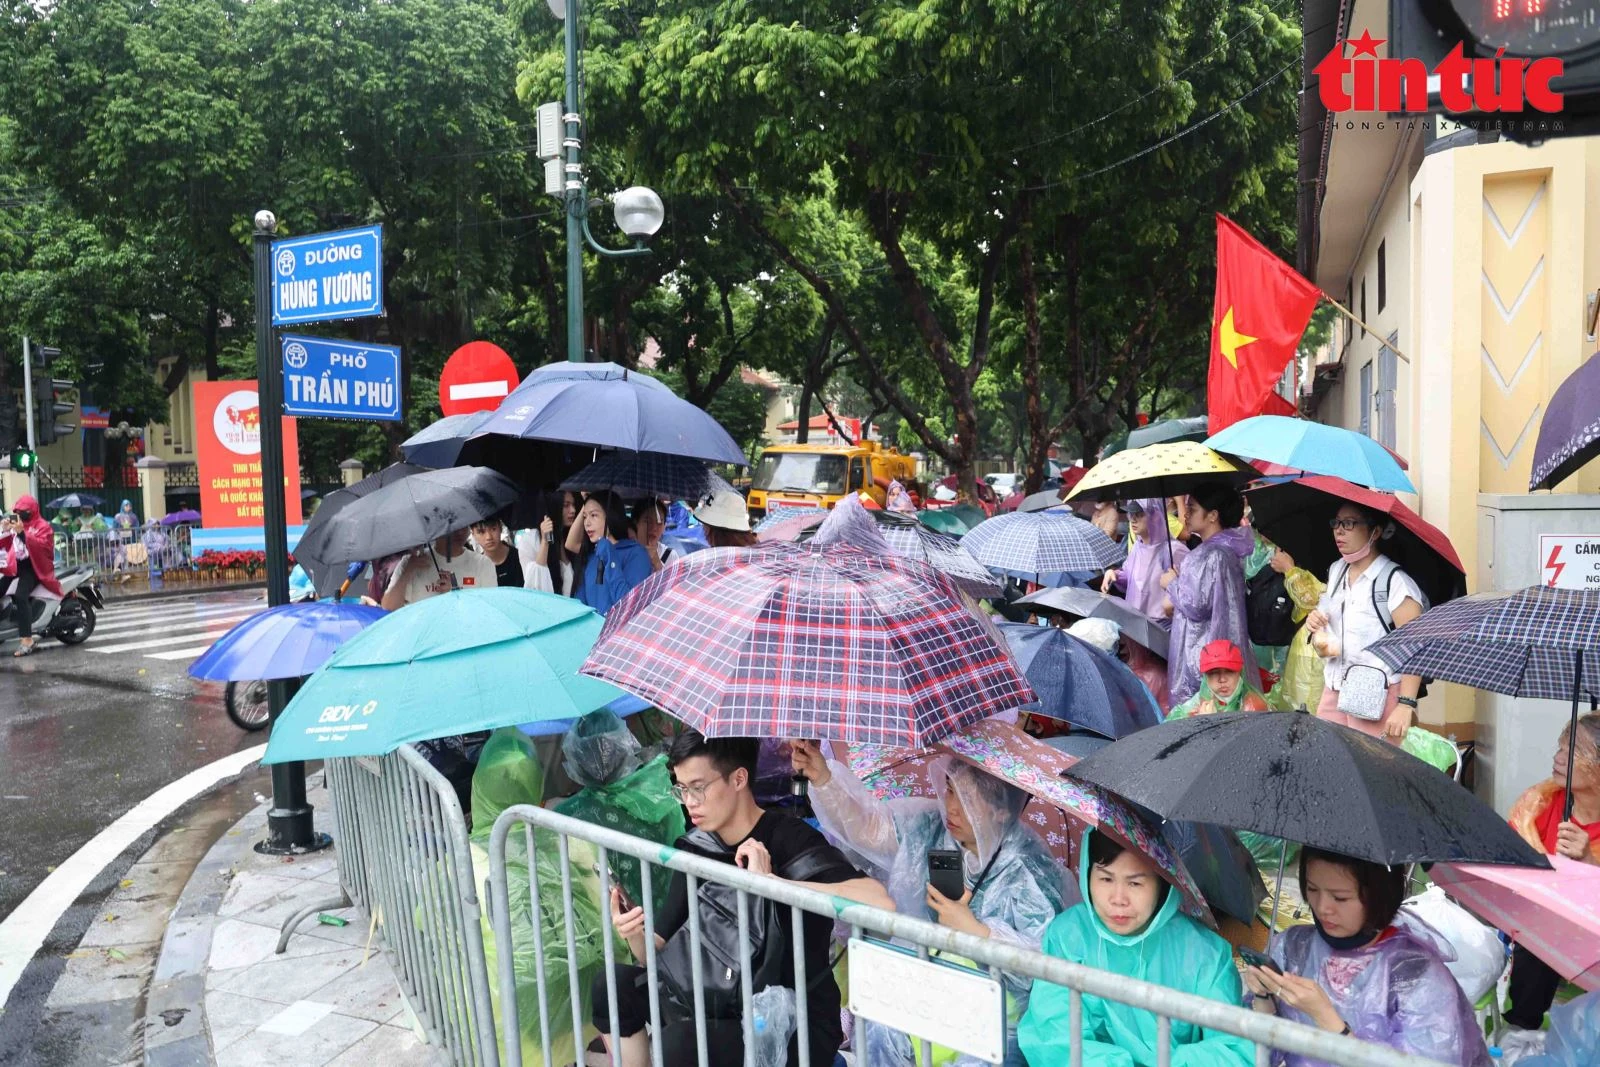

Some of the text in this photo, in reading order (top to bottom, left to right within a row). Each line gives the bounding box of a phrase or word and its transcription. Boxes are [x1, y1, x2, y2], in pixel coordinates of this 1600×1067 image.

[305, 243, 362, 266] ĐƯỜNG
[280, 271, 372, 310] HÙNG VƯƠNG
[330, 351, 368, 369] PHỐ
[288, 369, 393, 408] TRẦN PHÚ
[212, 475, 263, 490] CÁCH MẠNG THÁ
[220, 489, 263, 504] VÀ QUỐC KHÁ
[237, 504, 249, 517] BẤT
[1575, 539, 1600, 555] CẤM
